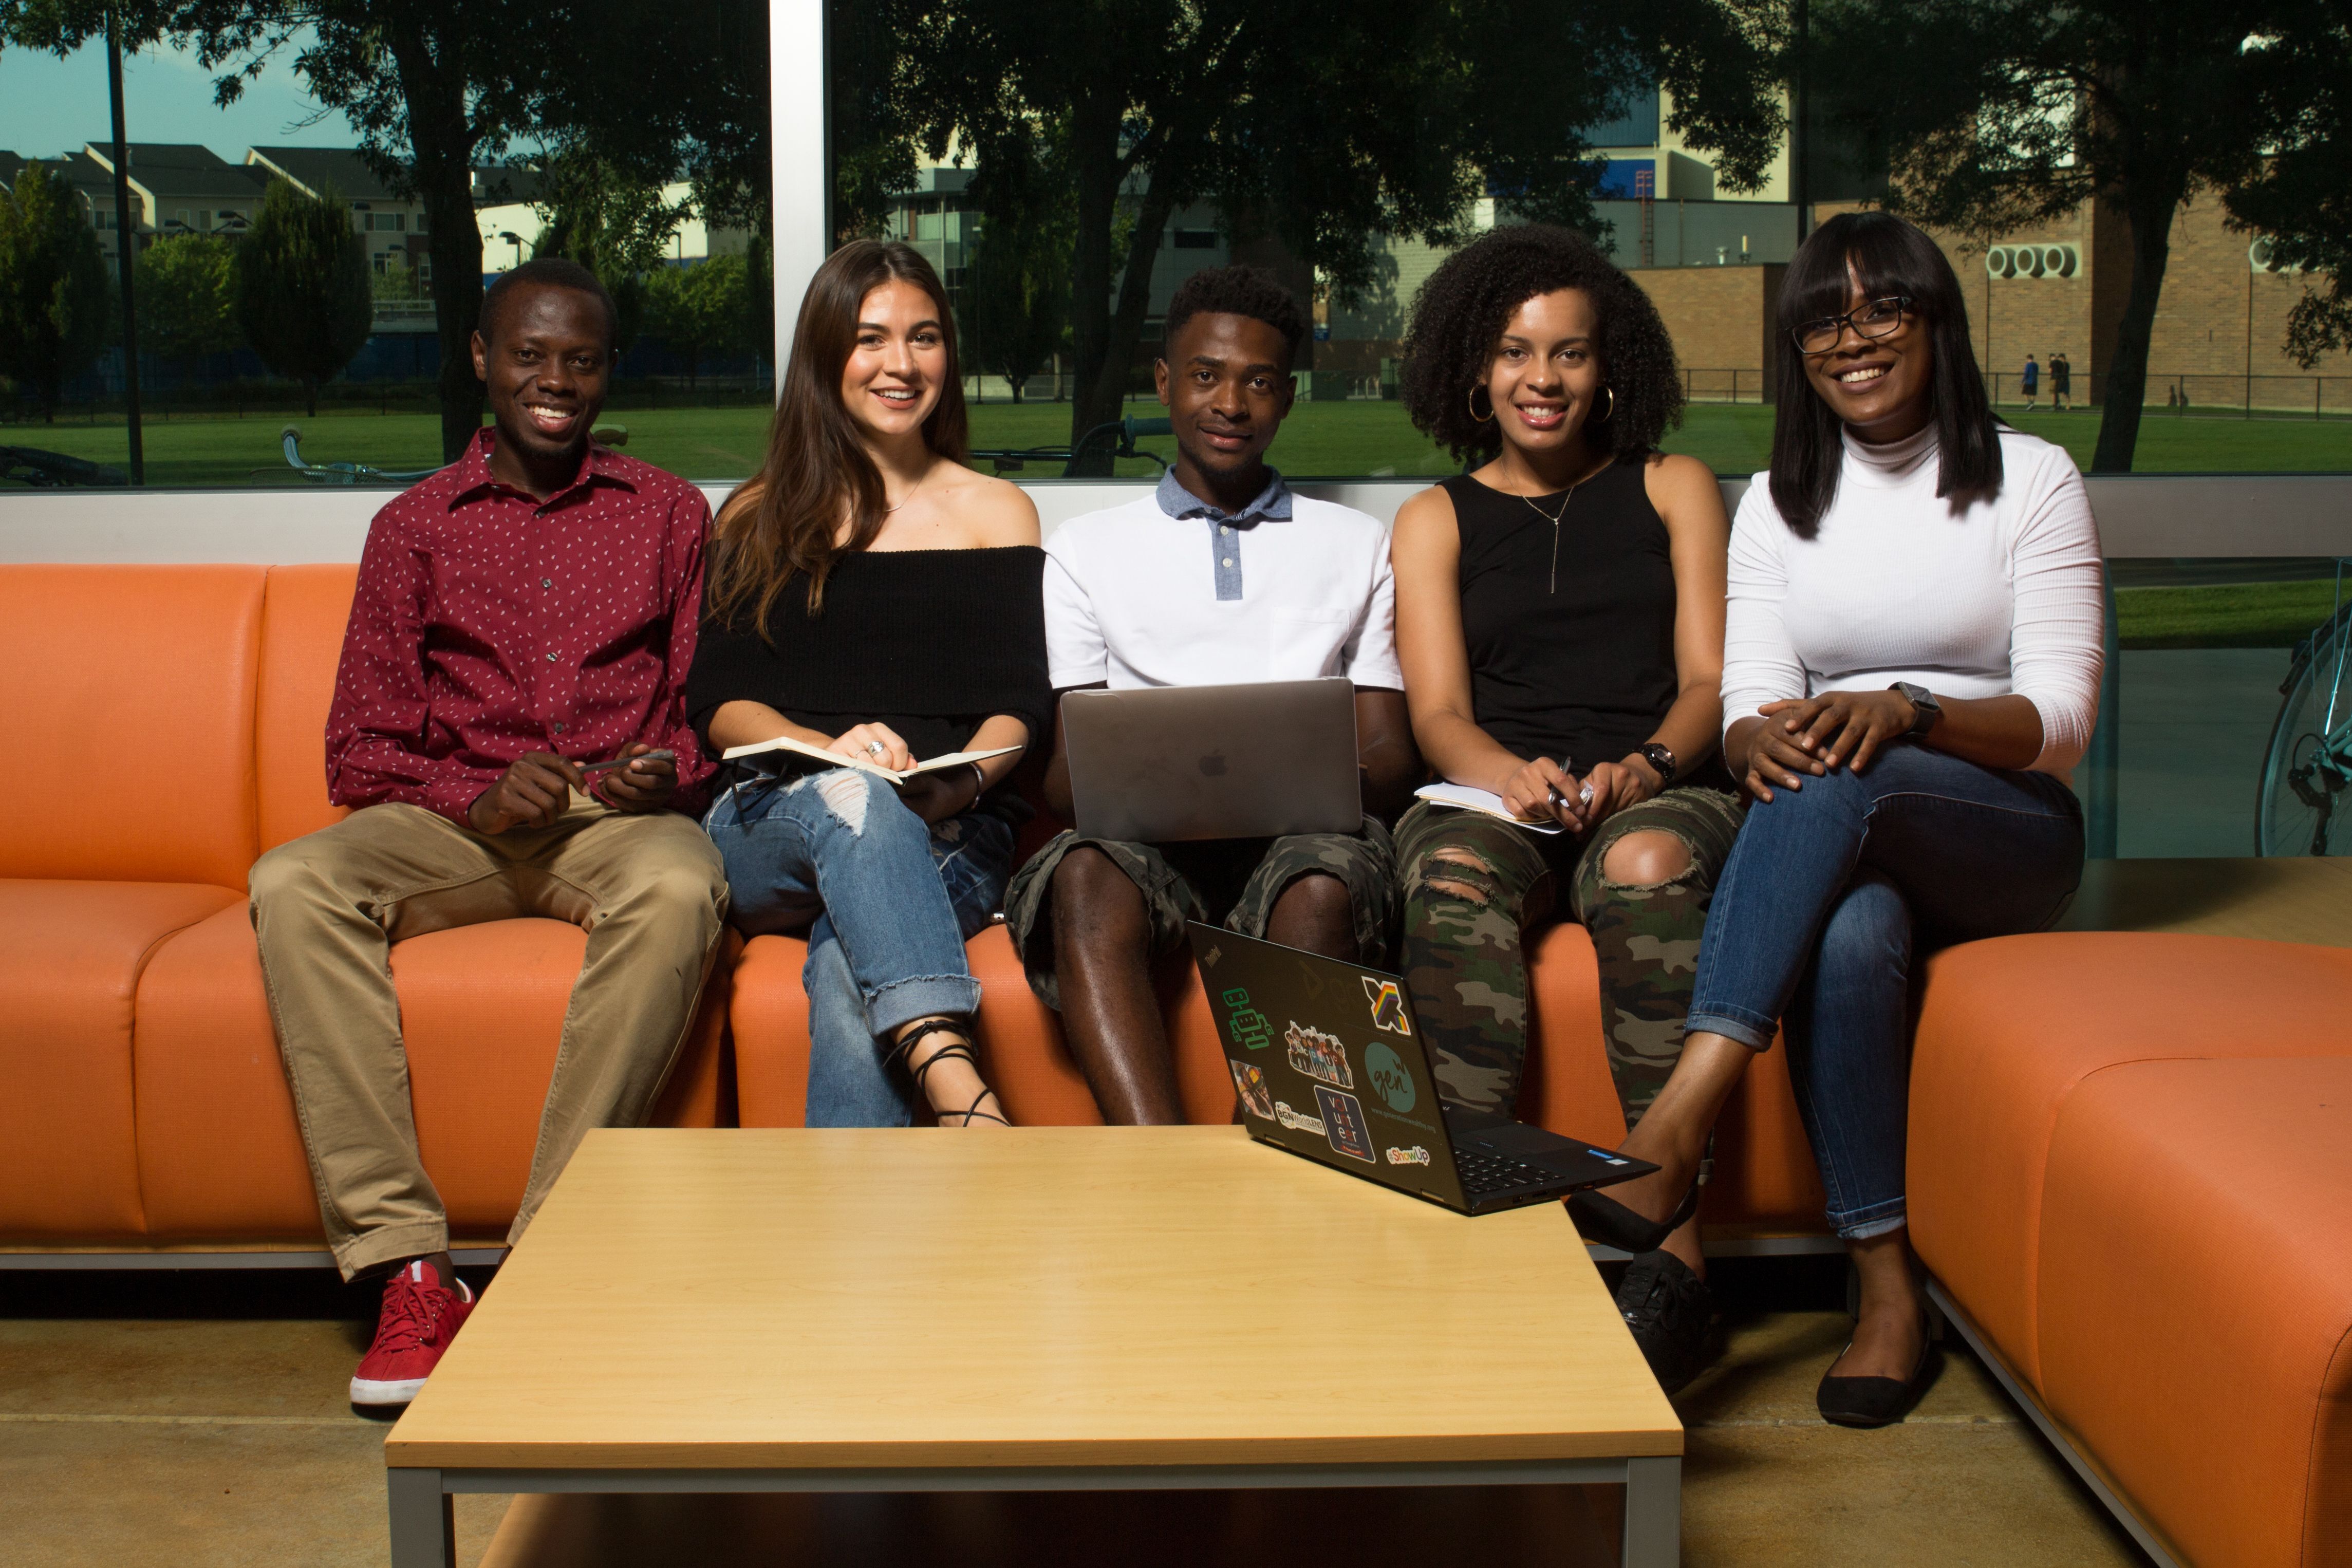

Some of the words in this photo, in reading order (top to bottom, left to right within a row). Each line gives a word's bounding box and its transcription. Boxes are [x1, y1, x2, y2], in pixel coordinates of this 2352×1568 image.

[1374, 1070, 1407, 1105] gen
[1328, 1096, 1348, 1112] vol
[1334, 1112, 1353, 1128] unt
[1338, 1127, 1356, 1142] eer
[1388, 1148, 1428, 1163] #ShowUp
